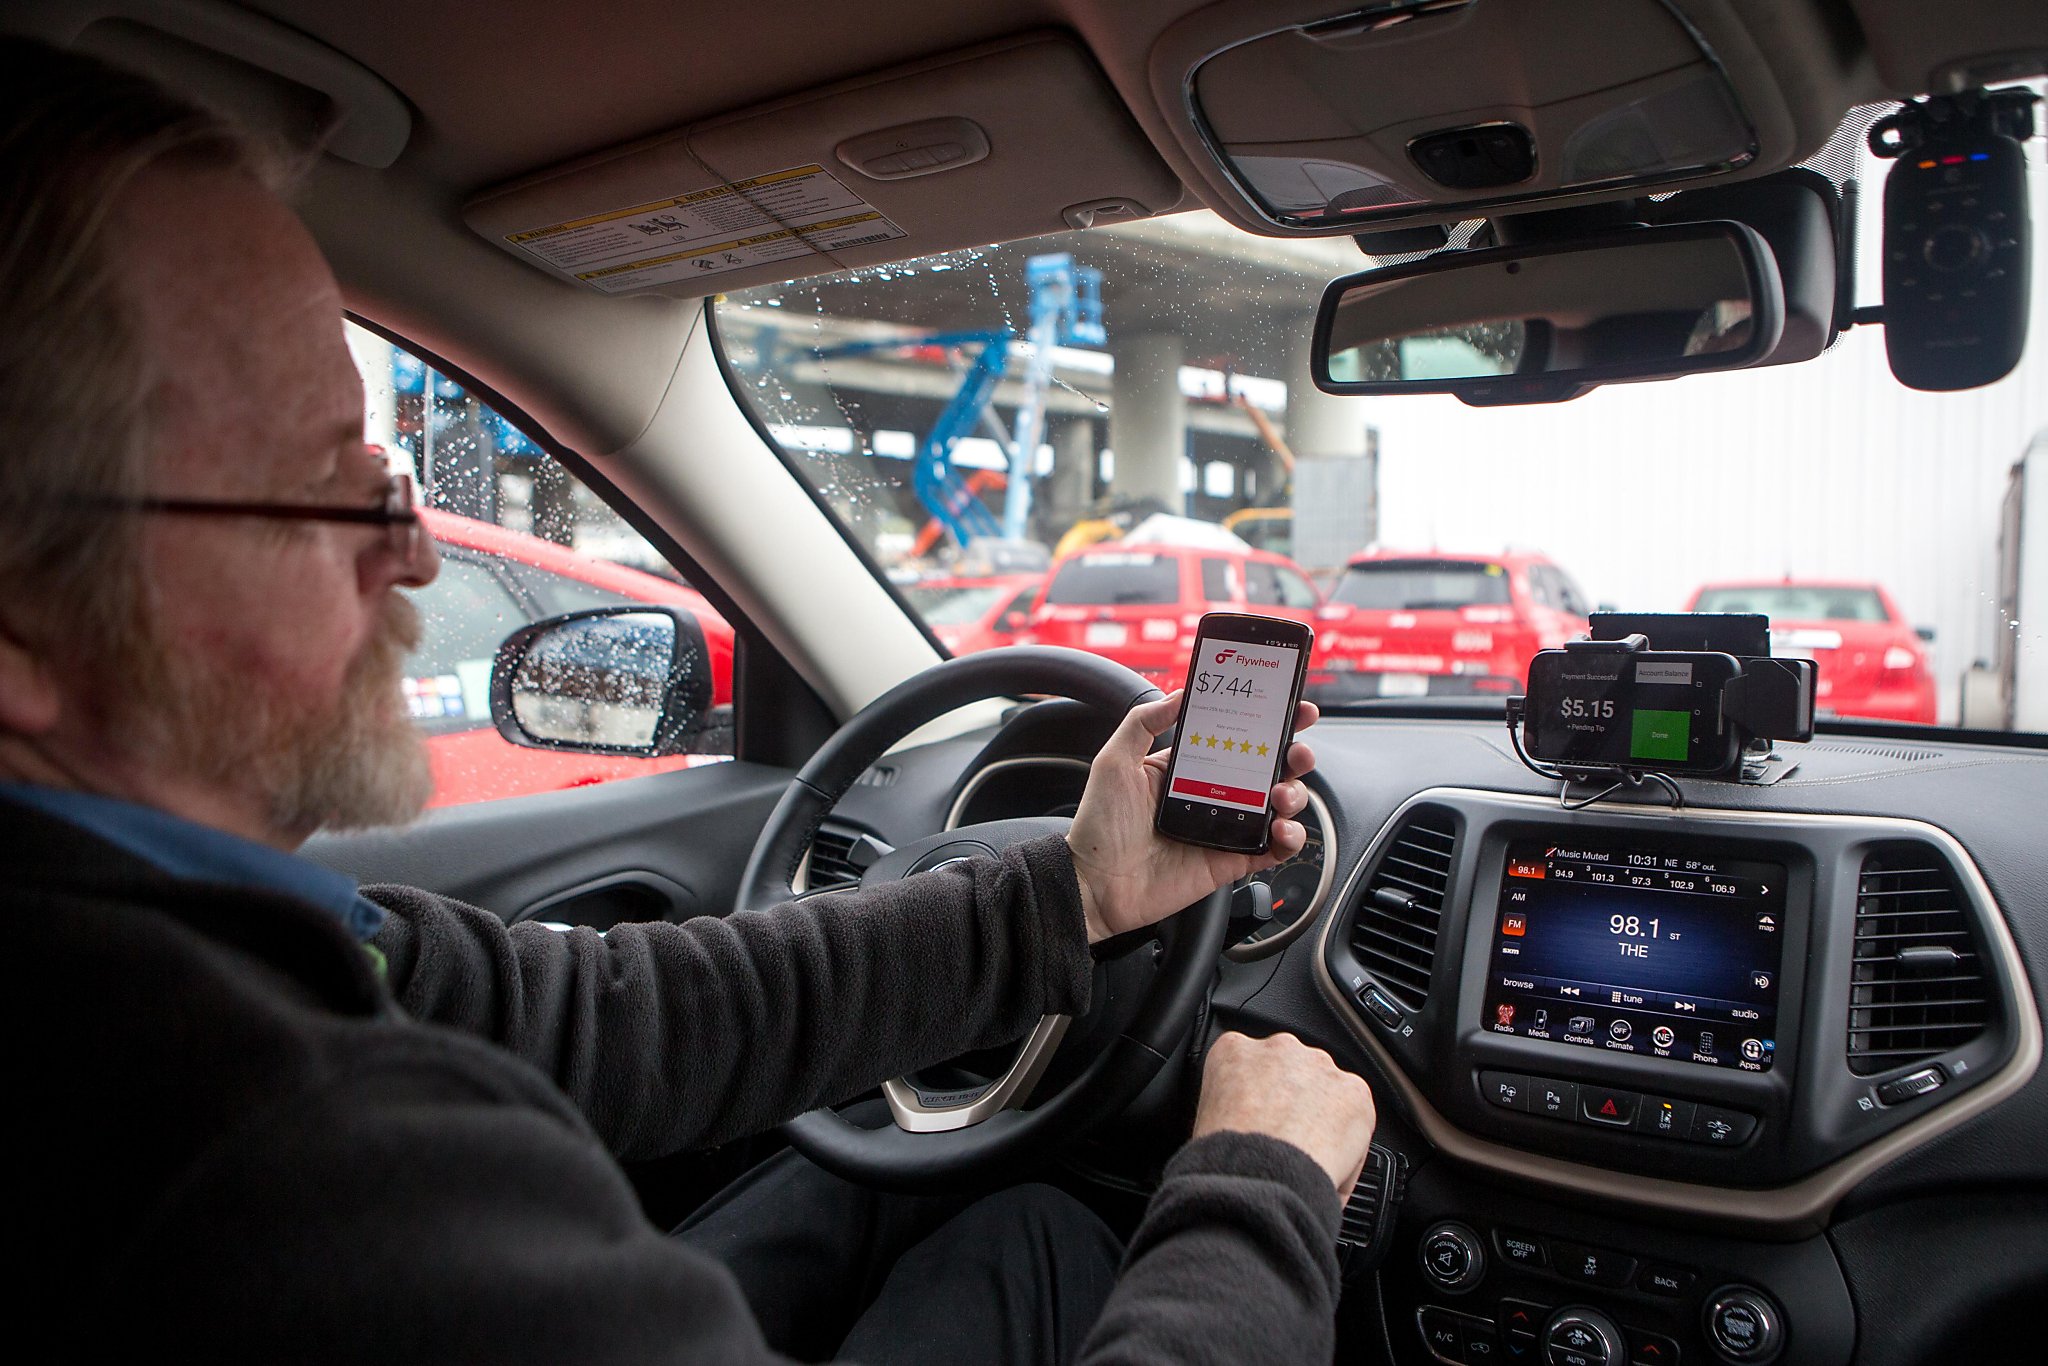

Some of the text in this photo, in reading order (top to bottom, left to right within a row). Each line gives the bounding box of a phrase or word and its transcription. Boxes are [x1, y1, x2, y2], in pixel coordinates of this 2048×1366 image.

[1236, 654, 1280, 669] Flywheel
[1561, 673, 1618, 682] Payment Successful
[1638, 669, 1689, 679] Account Balance
[1195, 670, 1253, 699] $7.44
[1561, 697, 1614, 719] $5.15
[1572, 723, 1594, 733] Pending
[1595, 724, 1605, 733] Tip
[1652, 731, 1668, 740] Done
[1210, 787, 1227, 797] Done
[1556, 849, 1580, 861] Music
[1582, 850, 1609, 862] Muted
[1627, 854, 1657, 867] 10:31
[1664, 859, 1678, 868] NE
[1702, 864, 1717, 872] out.
[1517, 865, 1535, 875] 98.1
[1555, 869, 1574, 879] 94.9
[1591, 872, 1614, 883] 101.3
[1632, 876, 1651, 886] 97.3
[1670, 880, 1694, 890] 102.9
[1711, 884, 1736, 894] 106.9
[1512, 892, 1526, 902] AM
[1508, 919, 1521, 929] FM
[1609, 914, 1681, 941] 98.1 ST
[1758, 923, 1775, 933] map
[1618, 942, 1649, 958] THE
[1503, 978, 1534, 990] browse
[1623, 993, 1643, 1004] tune
[1732, 1009, 1759, 1020] audio
[1494, 1023, 1514, 1034] Radio
[1528, 1028, 1550, 1039] Media
[1613, 1026, 1627, 1035] OFF
[1564, 1034, 1594, 1046] Controls
[1656, 1033, 1670, 1042] NE
[1606, 1040, 1634, 1052] Climate
[1654, 1047, 1670, 1057] Nav
[1693, 1052, 1718, 1064] Phone
[1740, 1060, 1761, 1071] Apps
[1659, 1122, 1672, 1130] OFF
[1712, 1132, 1725, 1140] OFF
[1438, 1240, 1459, 1251] VOLUME
[1506, 1239, 1536, 1253] SCREEN
[1512, 1249, 1528, 1259] OFF
[1584, 1267, 1597, 1276] OFF
[1654, 1276, 1678, 1289] BACK
[1435, 1330, 1454, 1344] A/C
[1571, 1337, 1586, 1347] OFF
[1566, 1355, 1586, 1366] AUTO
